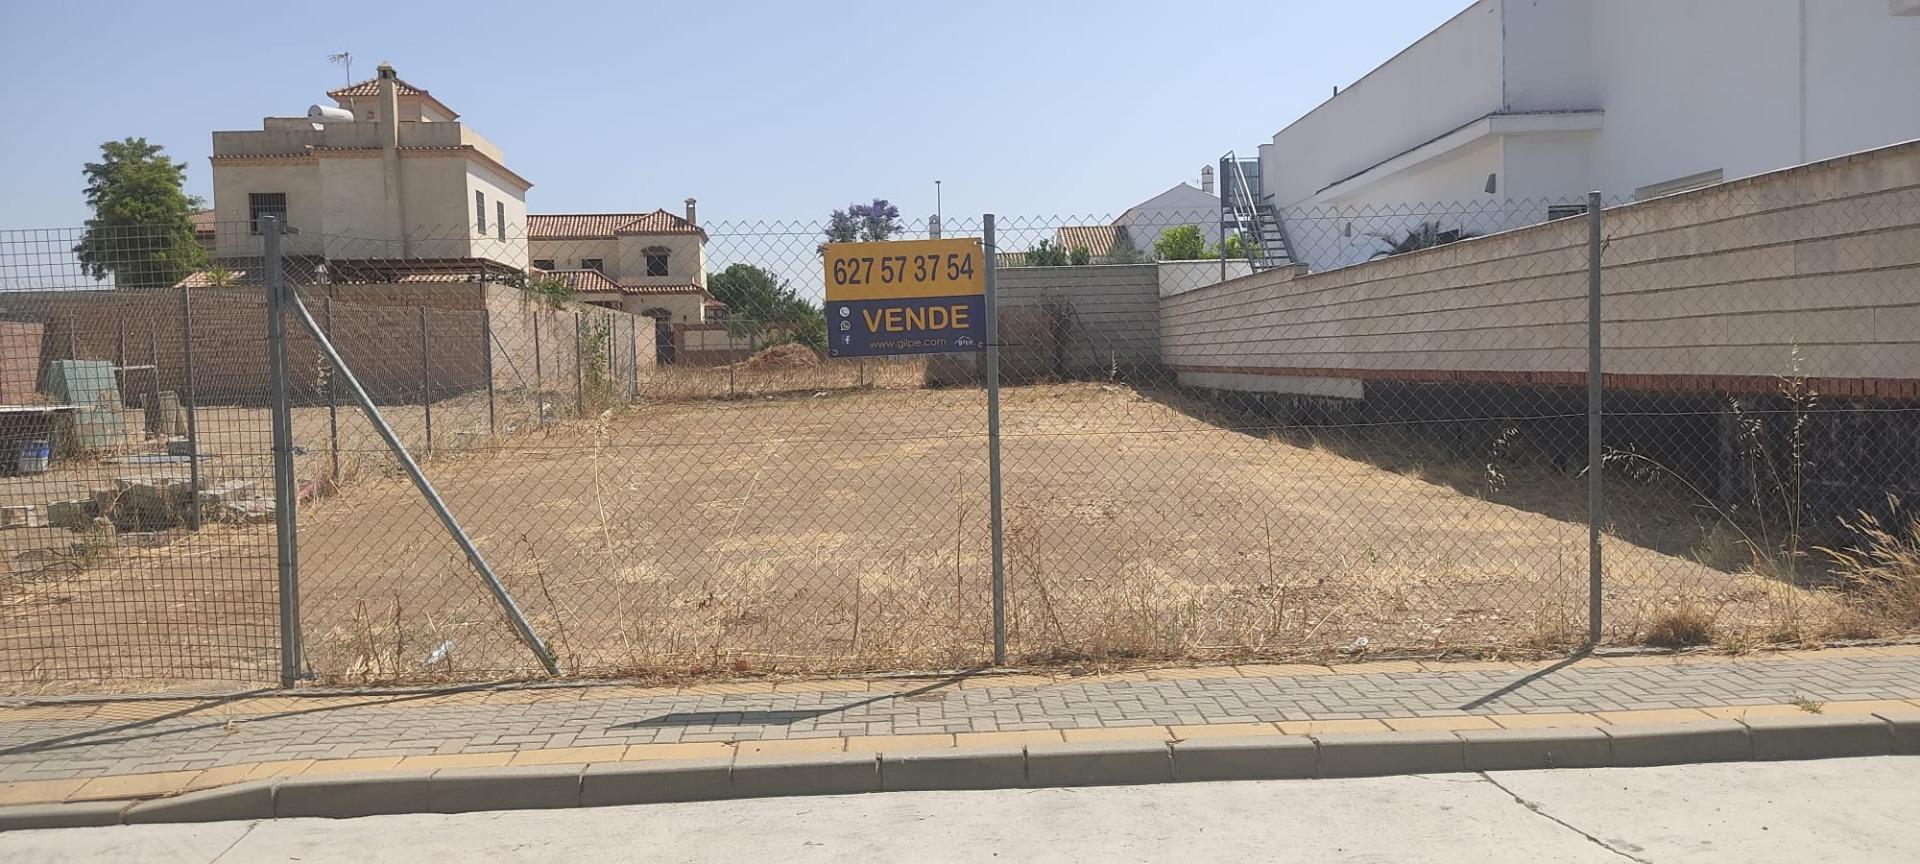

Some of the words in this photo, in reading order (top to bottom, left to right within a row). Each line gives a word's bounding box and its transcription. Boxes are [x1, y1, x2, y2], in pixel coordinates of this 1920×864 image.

[833, 258, 874, 286] 627
[881, 256, 907, 284] 57
[914, 254, 940, 282] 37
[947, 253, 974, 281] 54
[862, 304, 970, 333] VENDE
[869, 337, 947, 350] www.gilpe.com
